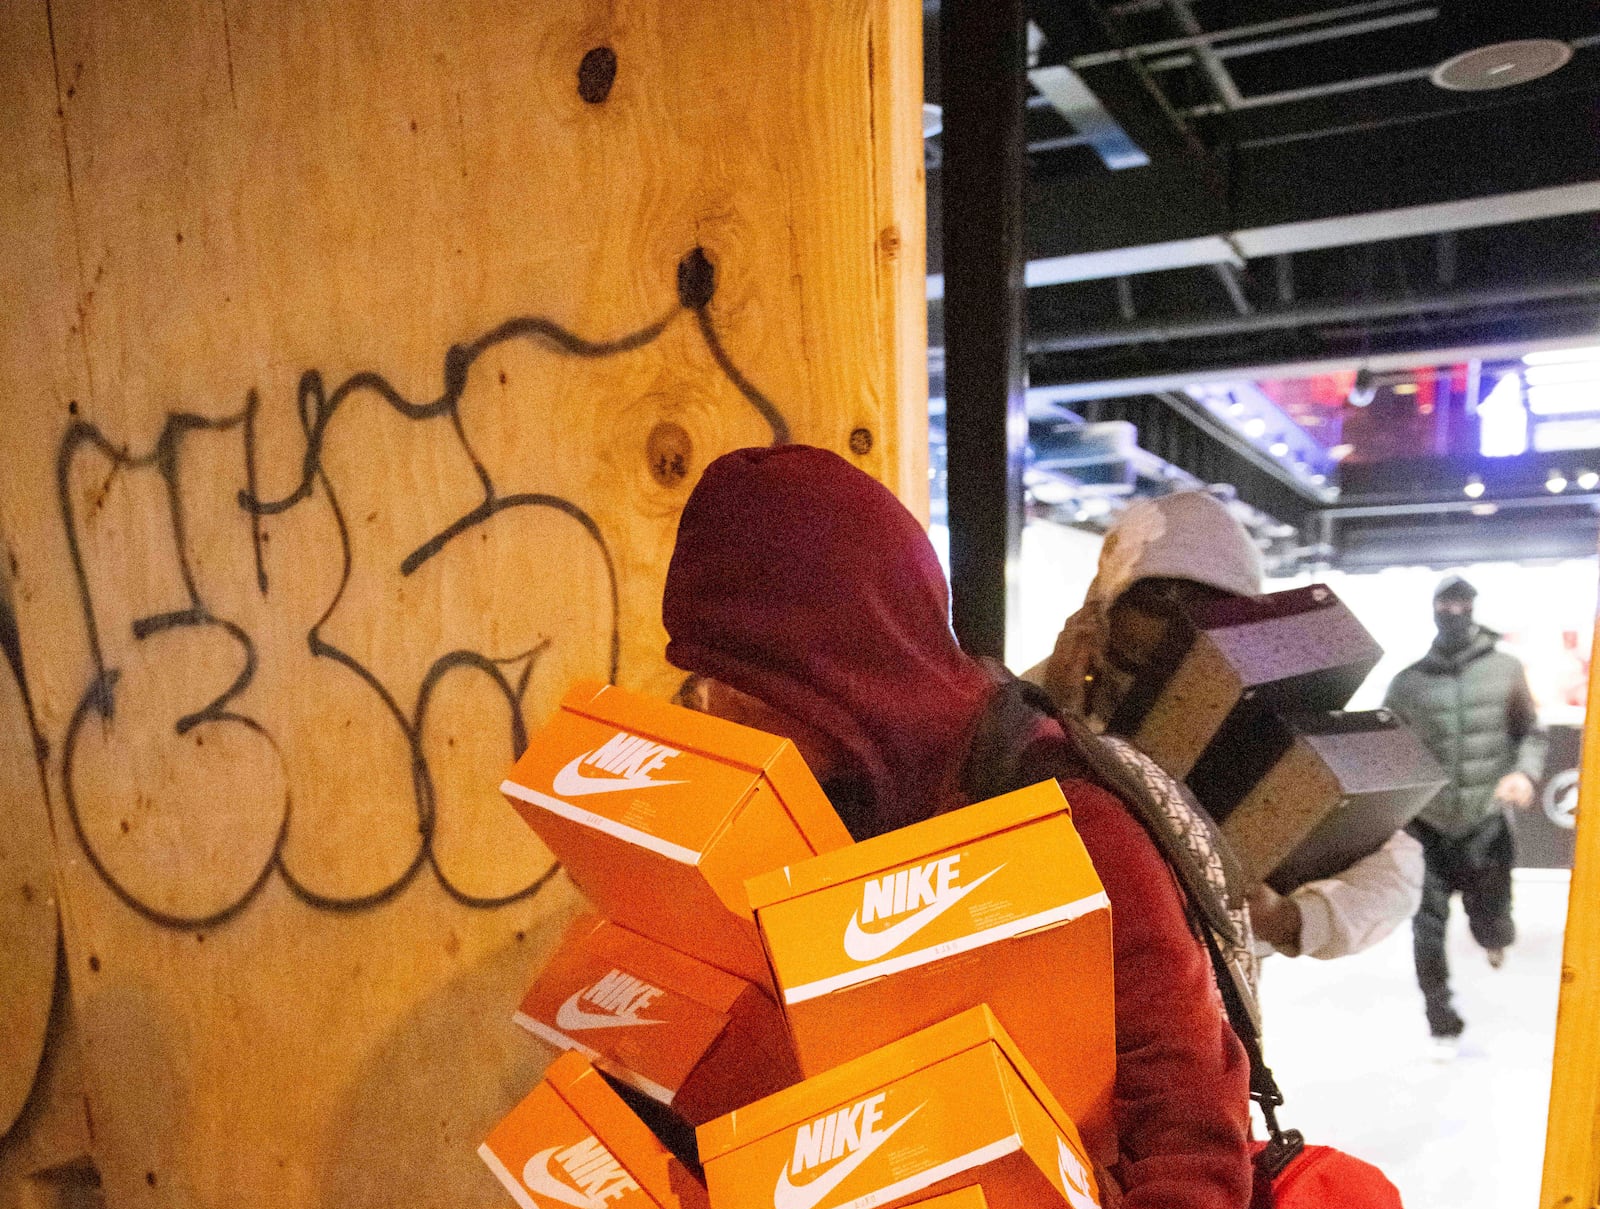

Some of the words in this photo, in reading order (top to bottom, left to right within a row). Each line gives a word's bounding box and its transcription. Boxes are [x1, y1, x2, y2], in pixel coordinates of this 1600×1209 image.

[584, 732, 681, 781] NIKE
[862, 853, 961, 925] NIKE
[581, 968, 666, 1020] NIKE
[791, 1091, 887, 1176] NIKE
[554, 1135, 641, 1209] NIKE
